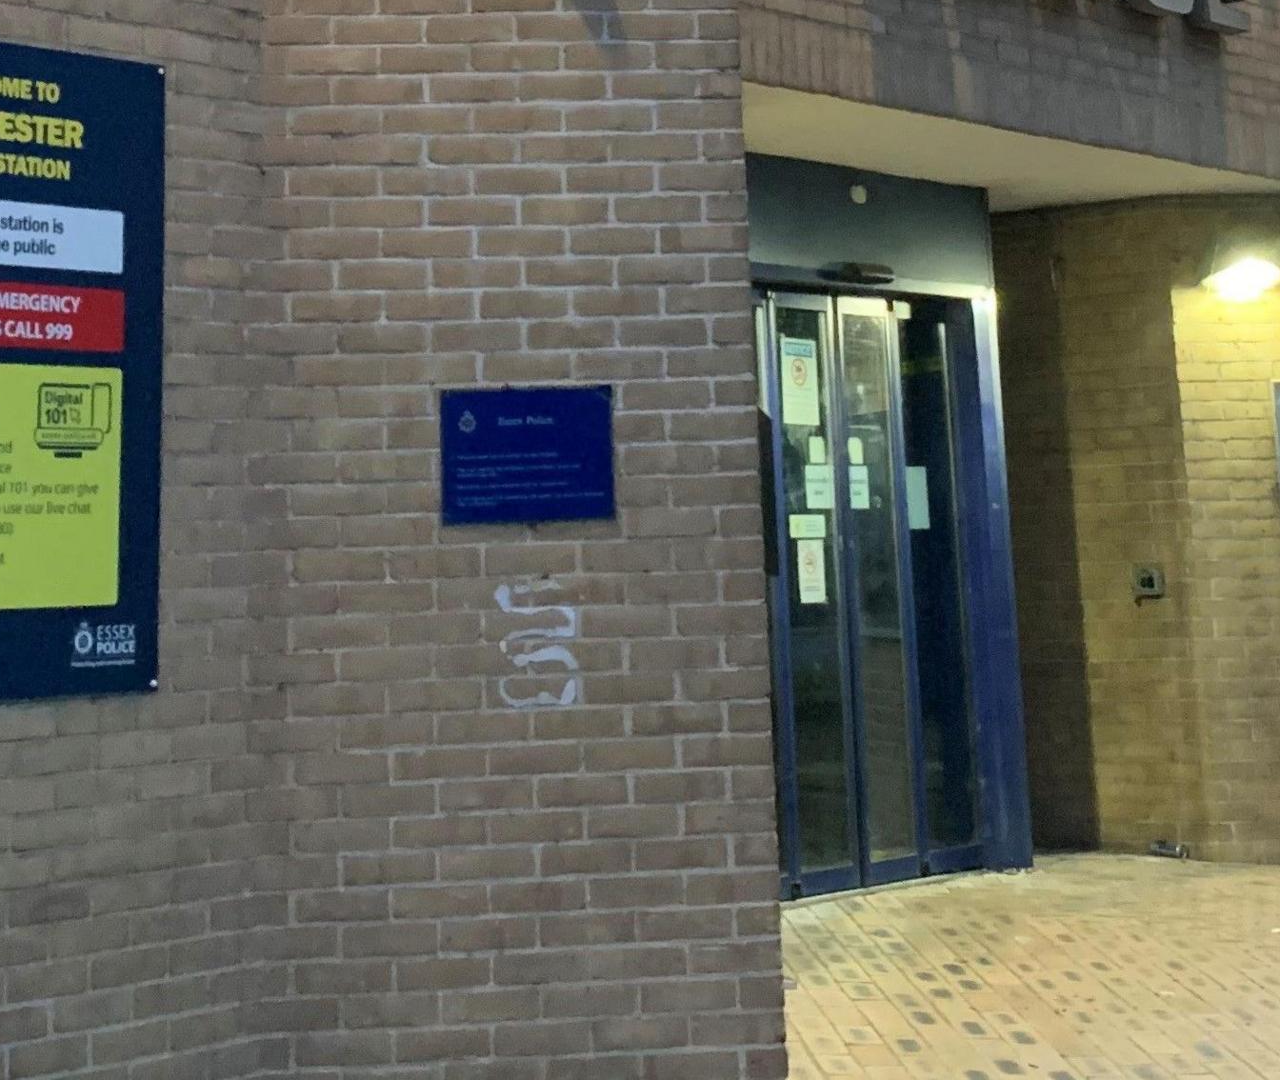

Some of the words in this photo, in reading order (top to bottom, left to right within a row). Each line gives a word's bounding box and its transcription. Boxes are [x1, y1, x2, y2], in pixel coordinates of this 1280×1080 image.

[36, 80, 60, 104] TO
[0, 215, 49, 233] station
[53, 218, 64, 234] is
[13, 239, 56, 256] public
[4, 320, 43, 339] CALL
[45, 323, 73, 340] 999
[44, 391, 83, 407] Digital
[45, 408, 67, 424] 101
[97, 624, 136, 640] ESSEX
[96, 640, 136, 654] POLICE
